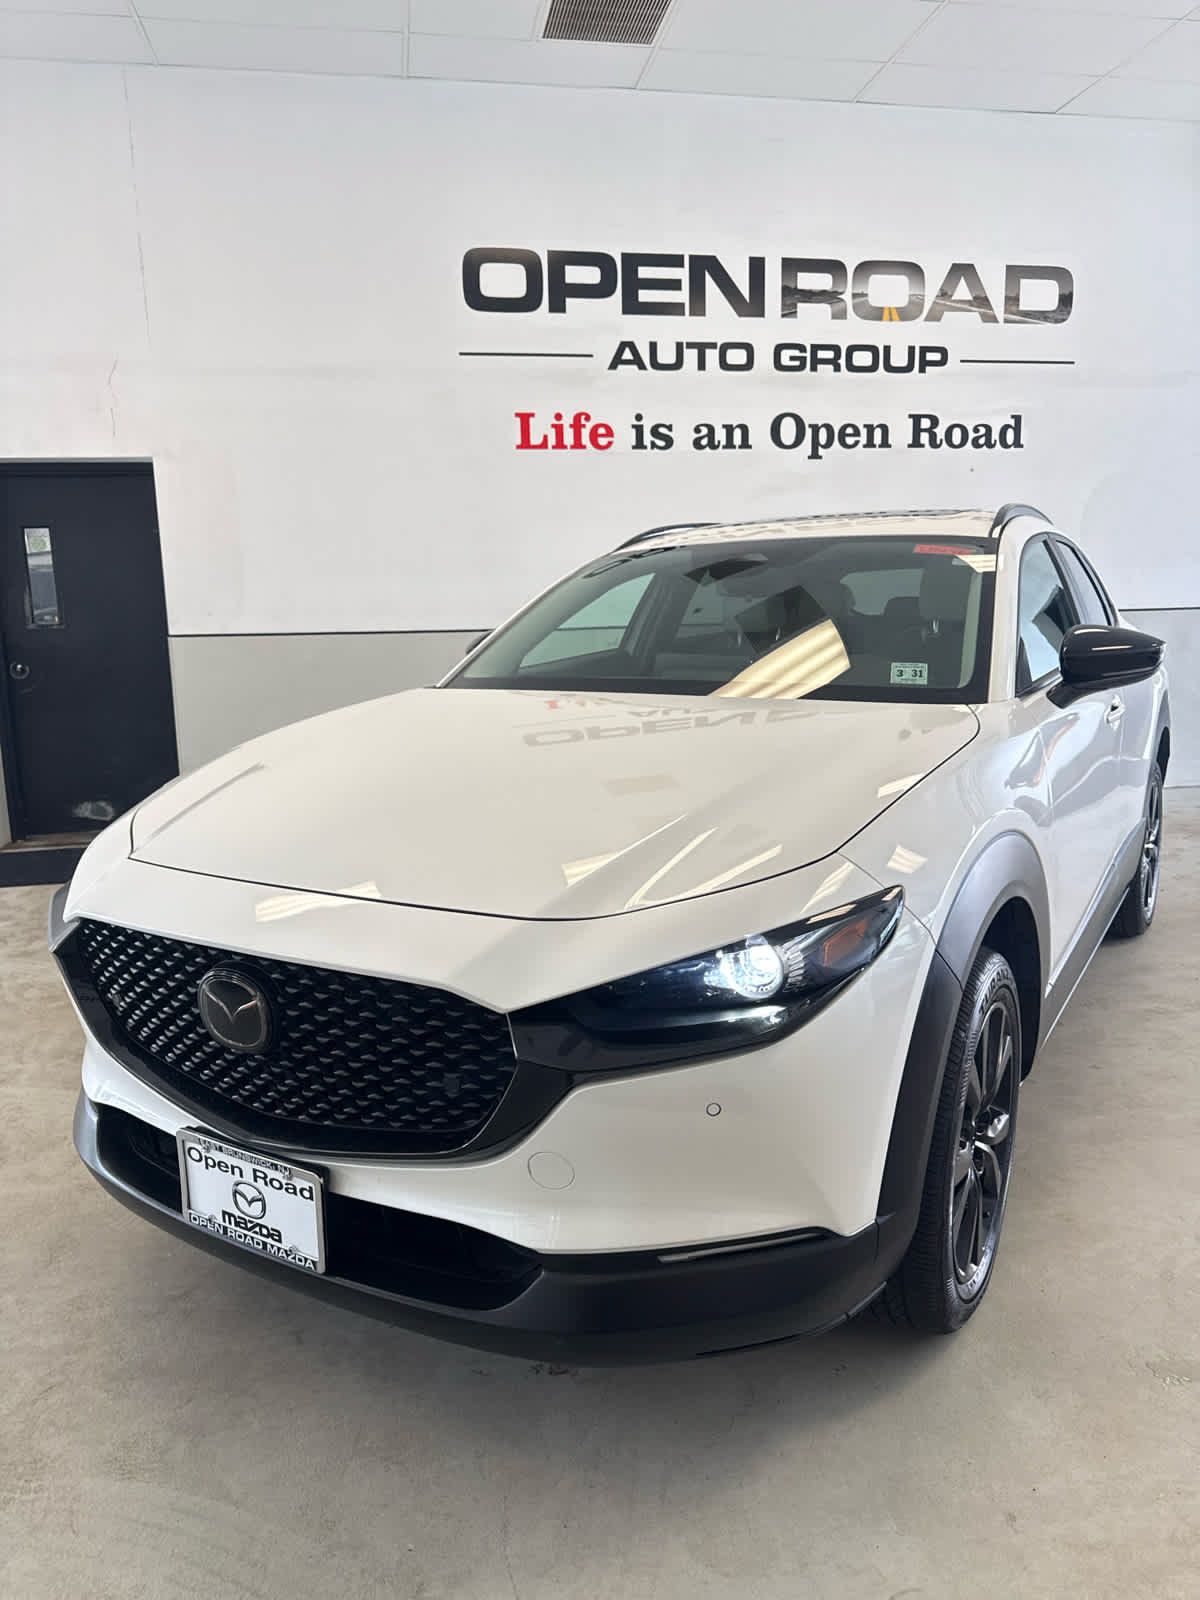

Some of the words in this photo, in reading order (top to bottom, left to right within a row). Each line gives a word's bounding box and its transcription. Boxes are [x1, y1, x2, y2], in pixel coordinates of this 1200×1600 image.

[462, 247, 765, 318] OPEN
[780, 256, 1074, 325] ROAD
[608, 341, 755, 371] AUTO
[773, 343, 949, 374] GROUP
[514, 411, 615, 451] Life
[631, 412, 675, 451] is
[692, 423, 753, 451] an
[769, 412, 892, 460] Open
[906, 413, 1024, 450] Road
[896, 669, 904, 678] 3
[911, 669, 923, 678] 31
[187, 1146, 244, 1178] Open
[252, 1168, 315, 1201] Road
[190, 1213, 224, 1233] OPEN
[228, 1228, 263, 1249] ROAD
[267, 1242, 316, 1271] MAZDA
